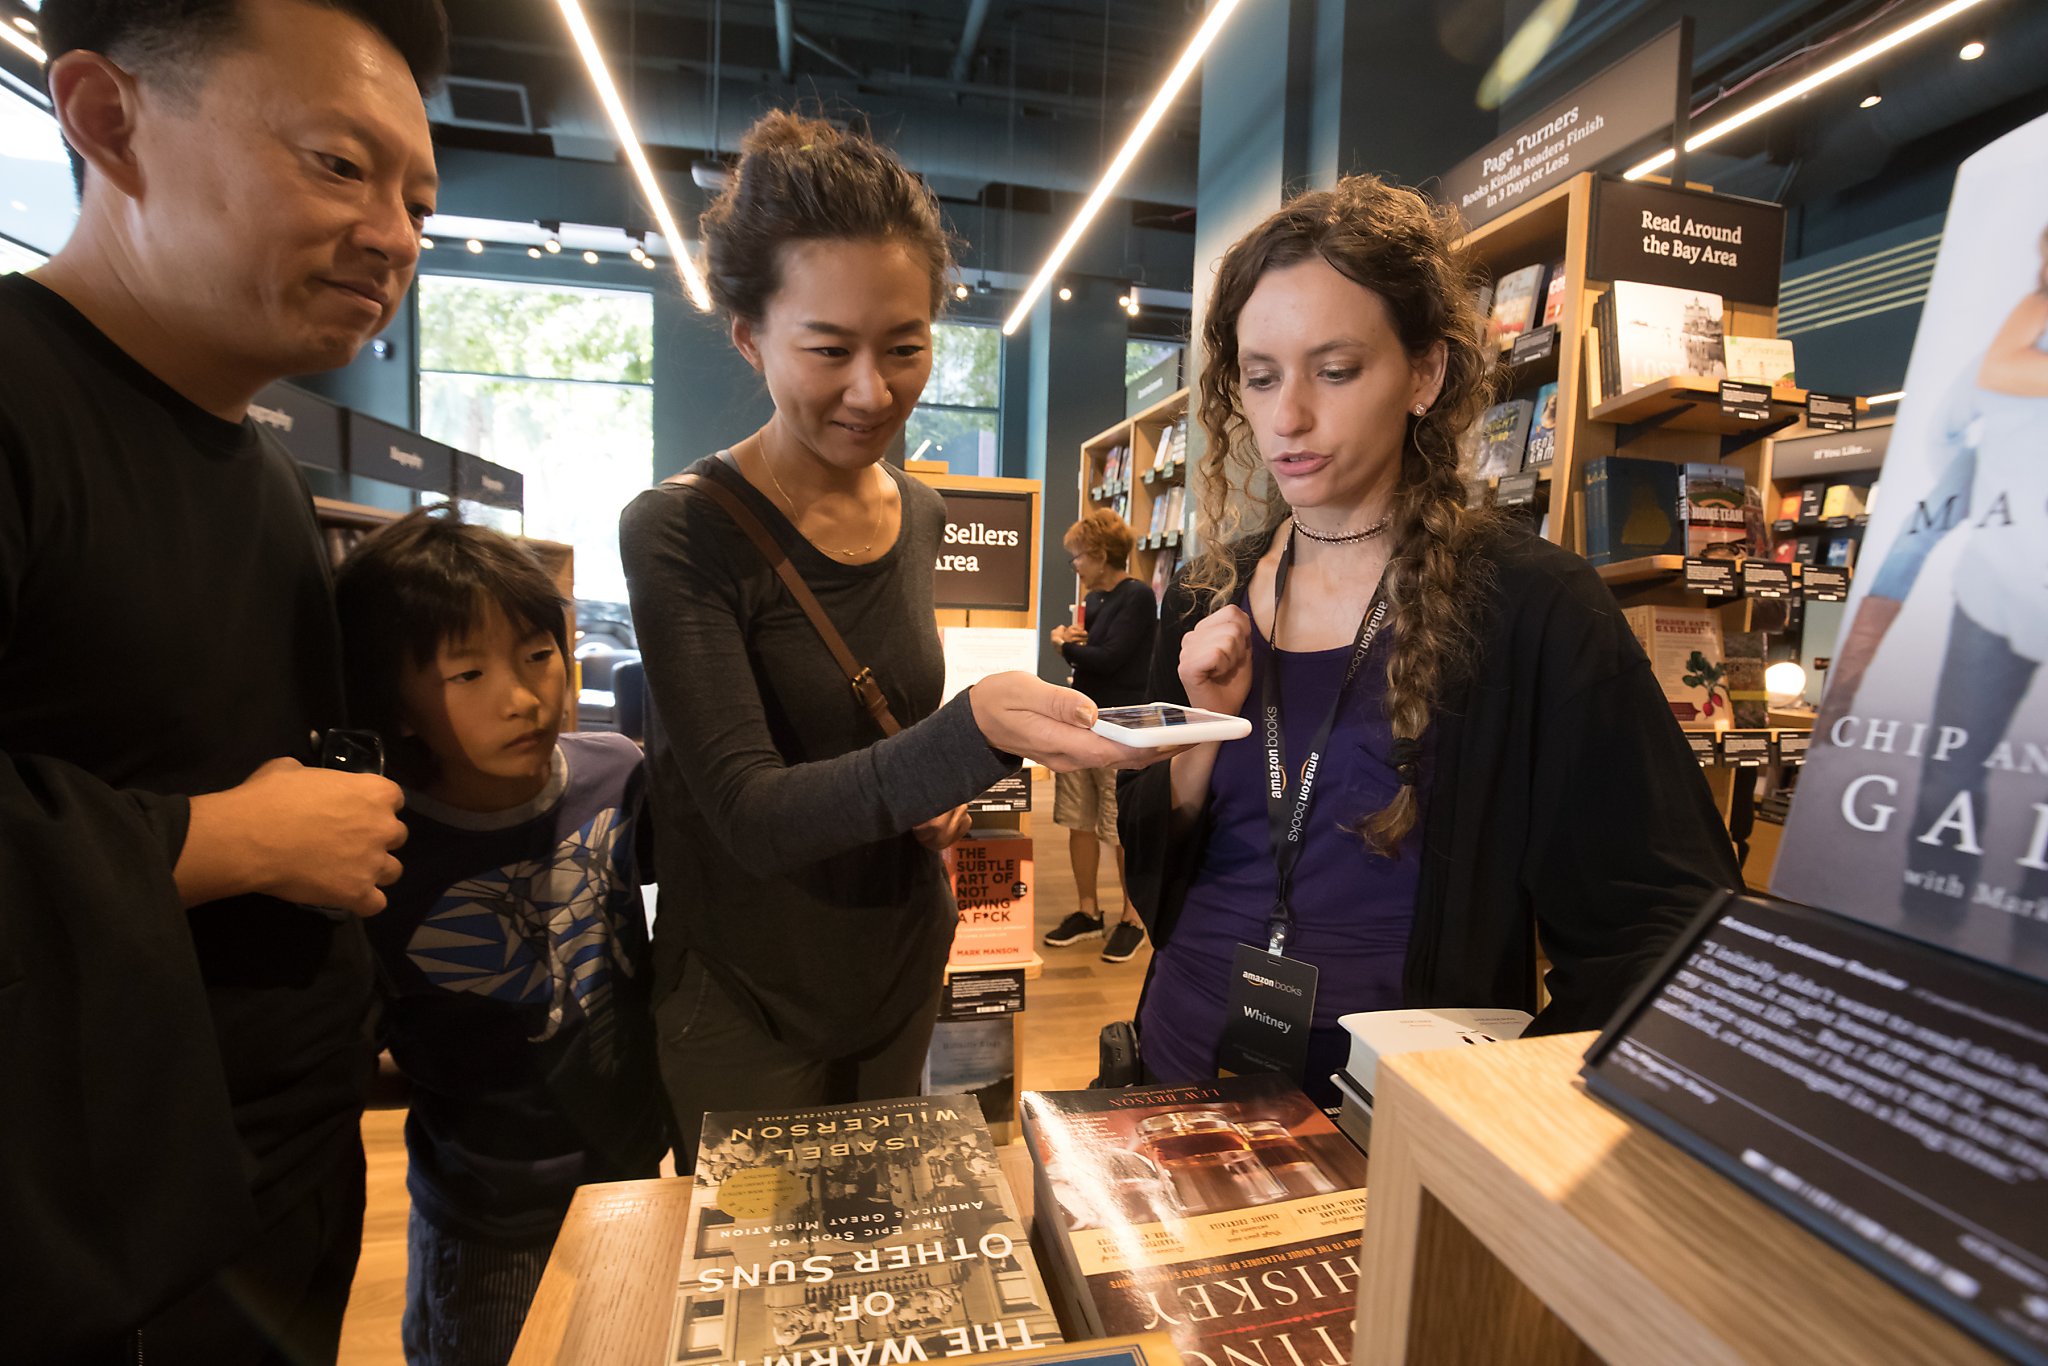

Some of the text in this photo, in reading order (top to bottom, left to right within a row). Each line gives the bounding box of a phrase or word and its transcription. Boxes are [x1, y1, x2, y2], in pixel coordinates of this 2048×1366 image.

[1482, 106, 1579, 177] Page Turners
[1462, 115, 1605, 208] Books Kindle Readers Finish
[1487, 153, 1570, 209] in 3 Days or Less
[1641, 210, 1742, 244] Read Around
[1643, 234, 1738, 267] the Bay Area
[1907, 491, 2048, 535] MA
[944, 522, 1019, 547] Sellers
[1360, 601, 1389, 649] amazon
[1264, 706, 1282, 799] amazon books
[1830, 715, 1969, 762] CHIP
[1287, 752, 1319, 842] amazon books
[956, 847, 986, 859] THE
[957, 860, 1014, 872] SUBTLE
[957, 872, 1013, 885] ART OF
[957, 886, 989, 898] NOT
[1903, 868, 1965, 899] with
[957, 898, 1010, 911] GIVING
[959, 913, 968, 923] A
[983, 947, 1019, 955] MANSON
[1242, 970, 1303, 997] amazon books
[1243, 1005, 1292, 1034] Whitney
[1108, 1088, 1220, 1107] LEW BRYSON
[731, 1109, 959, 1141] WILKERSON
[774, 1135, 920, 1161] ISABEL
[720, 1200, 984, 1239] AMERICA'S GREAT MIGRATION
[768, 1221, 944, 1248] THE EPIC STORY OF
[1315, 1244, 1333, 1254] THE
[699, 1233, 1013, 1293] OTHER SUNS
[1210, 1264, 1230, 1273] THE
[1230, 1262, 1241, 1270] OF
[1242, 1253, 1288, 1268] PLEASURES
[1288, 1248, 1316, 1260] UNIQUE
[834, 1291, 895, 1322] OF
[704, 1319, 1046, 1366] THE WARM
[1180, 1319, 1357, 1366] TIN
